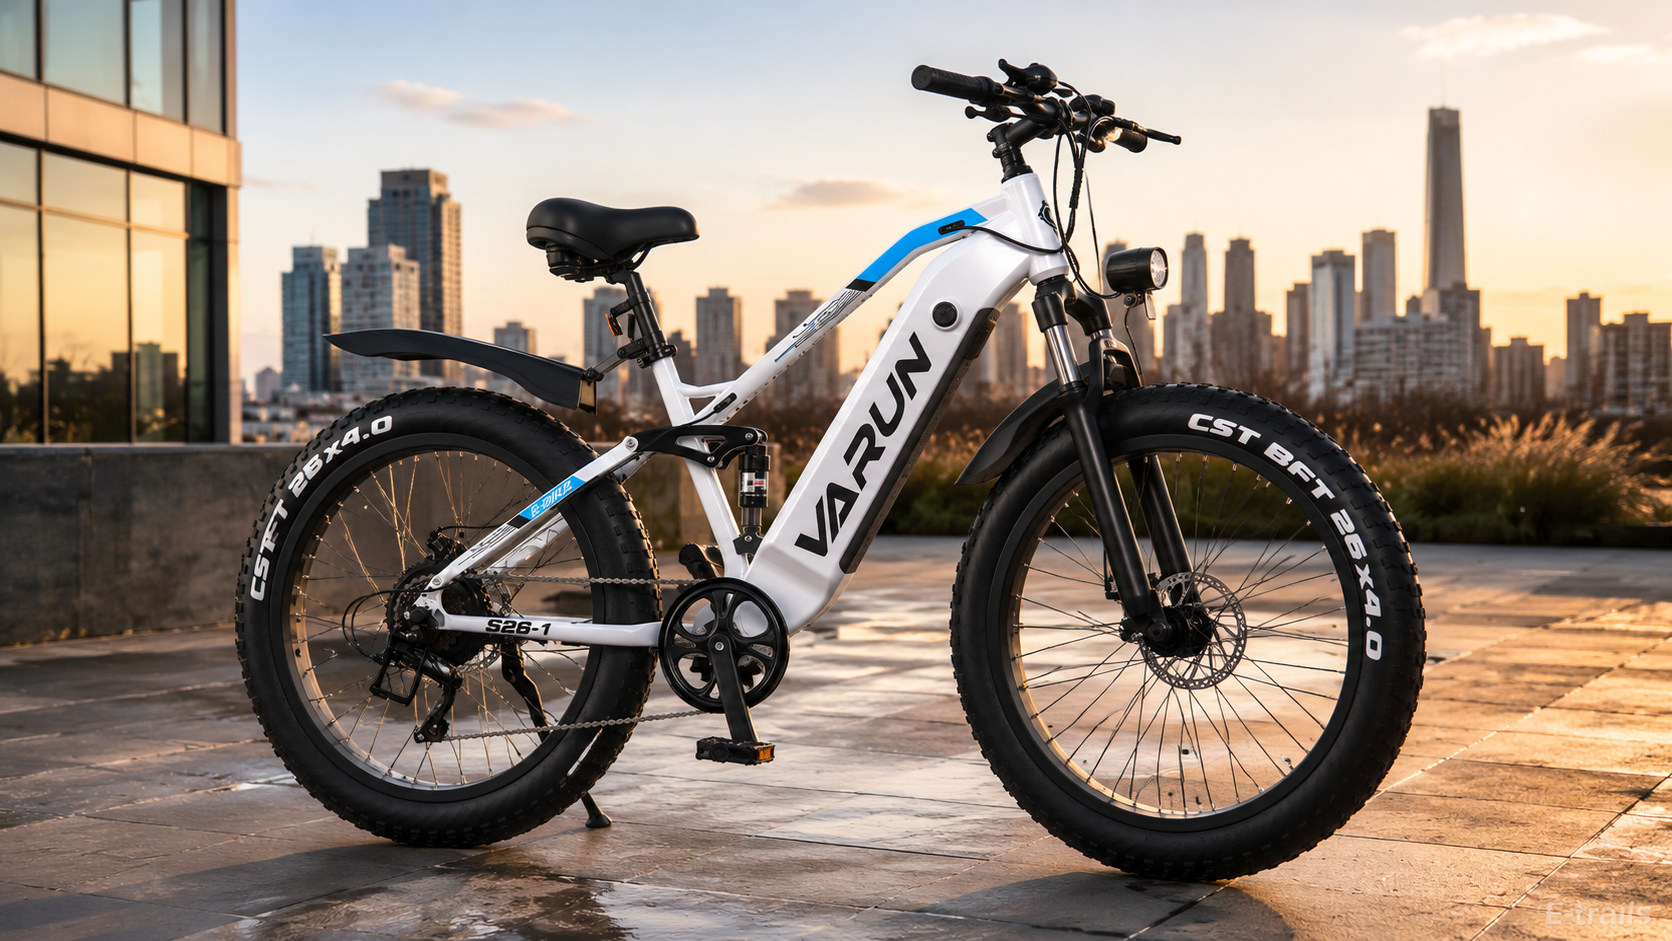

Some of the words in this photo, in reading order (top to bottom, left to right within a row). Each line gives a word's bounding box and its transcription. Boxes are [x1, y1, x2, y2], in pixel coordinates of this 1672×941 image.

[794, 331, 932, 557] VARUN
[1188, 413, 1261, 445] CST
[1264, 441, 1336, 500] BFT
[485, 618, 552, 636] S26-1
